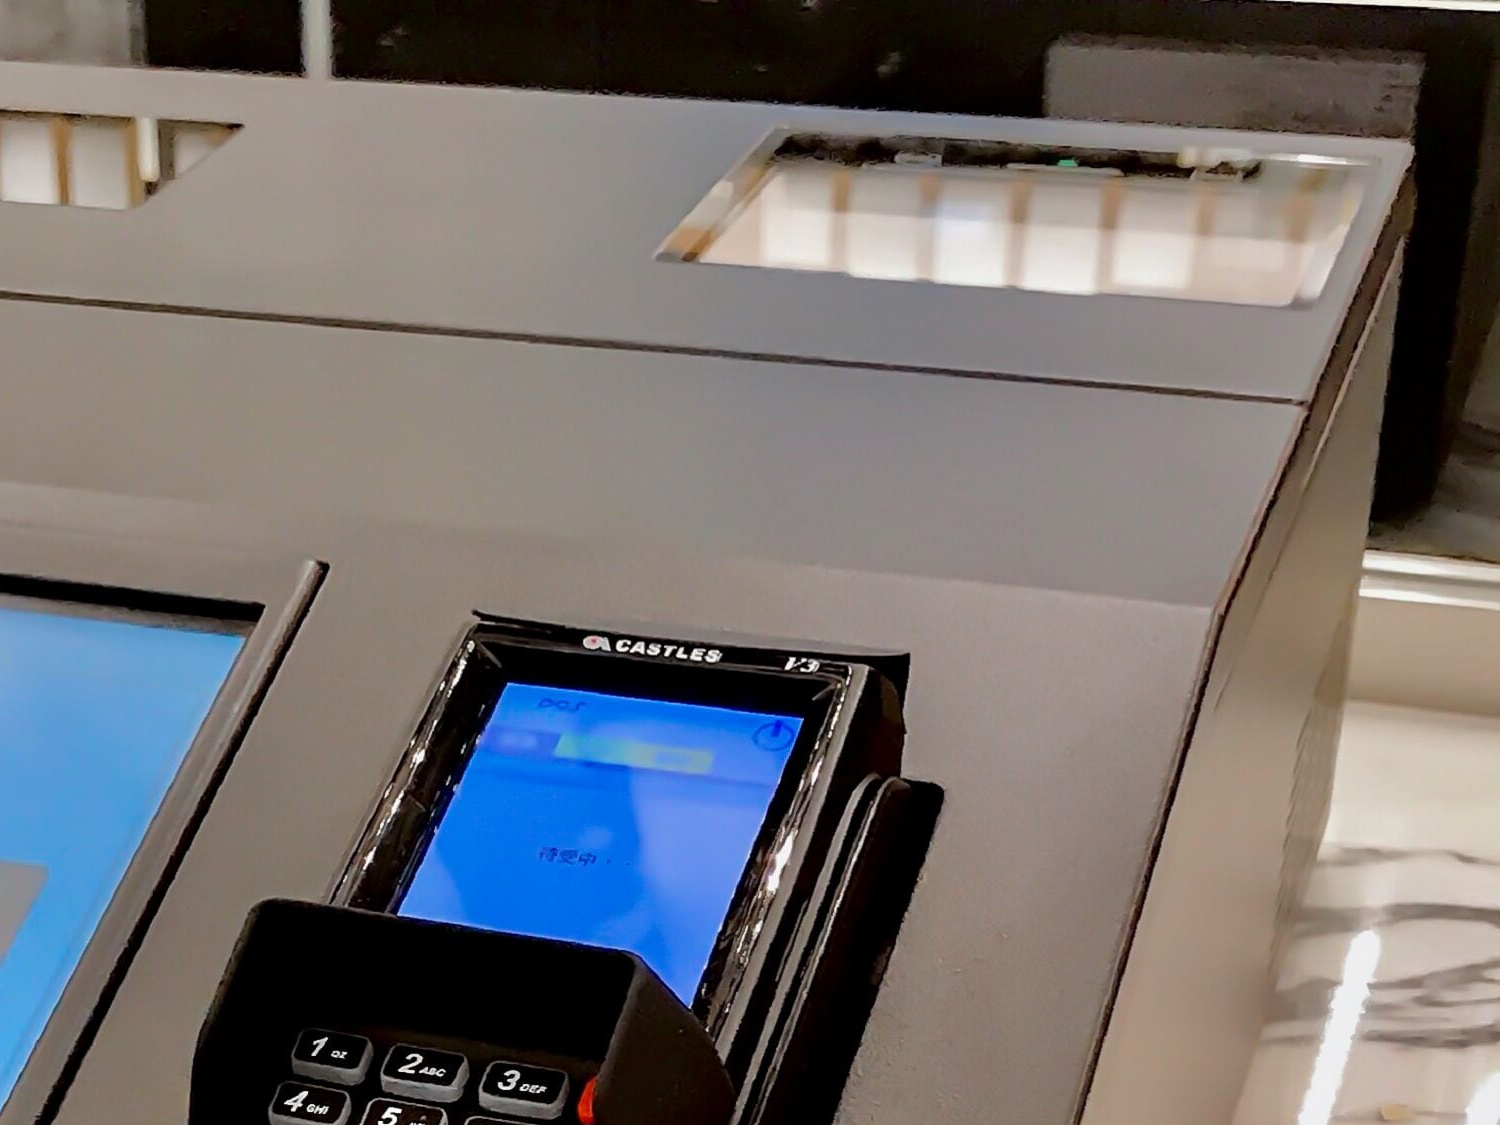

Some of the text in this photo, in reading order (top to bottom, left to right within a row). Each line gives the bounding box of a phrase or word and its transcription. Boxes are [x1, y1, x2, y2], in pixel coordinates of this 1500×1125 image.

[615, 638, 723, 663] CASTLES
[310, 1036, 329, 1057] 1
[398, 1053, 447, 1078] 2 ABC
[497, 1069, 548, 1095] 3 DEF
[283, 1090, 330, 1116] 4 GHI
